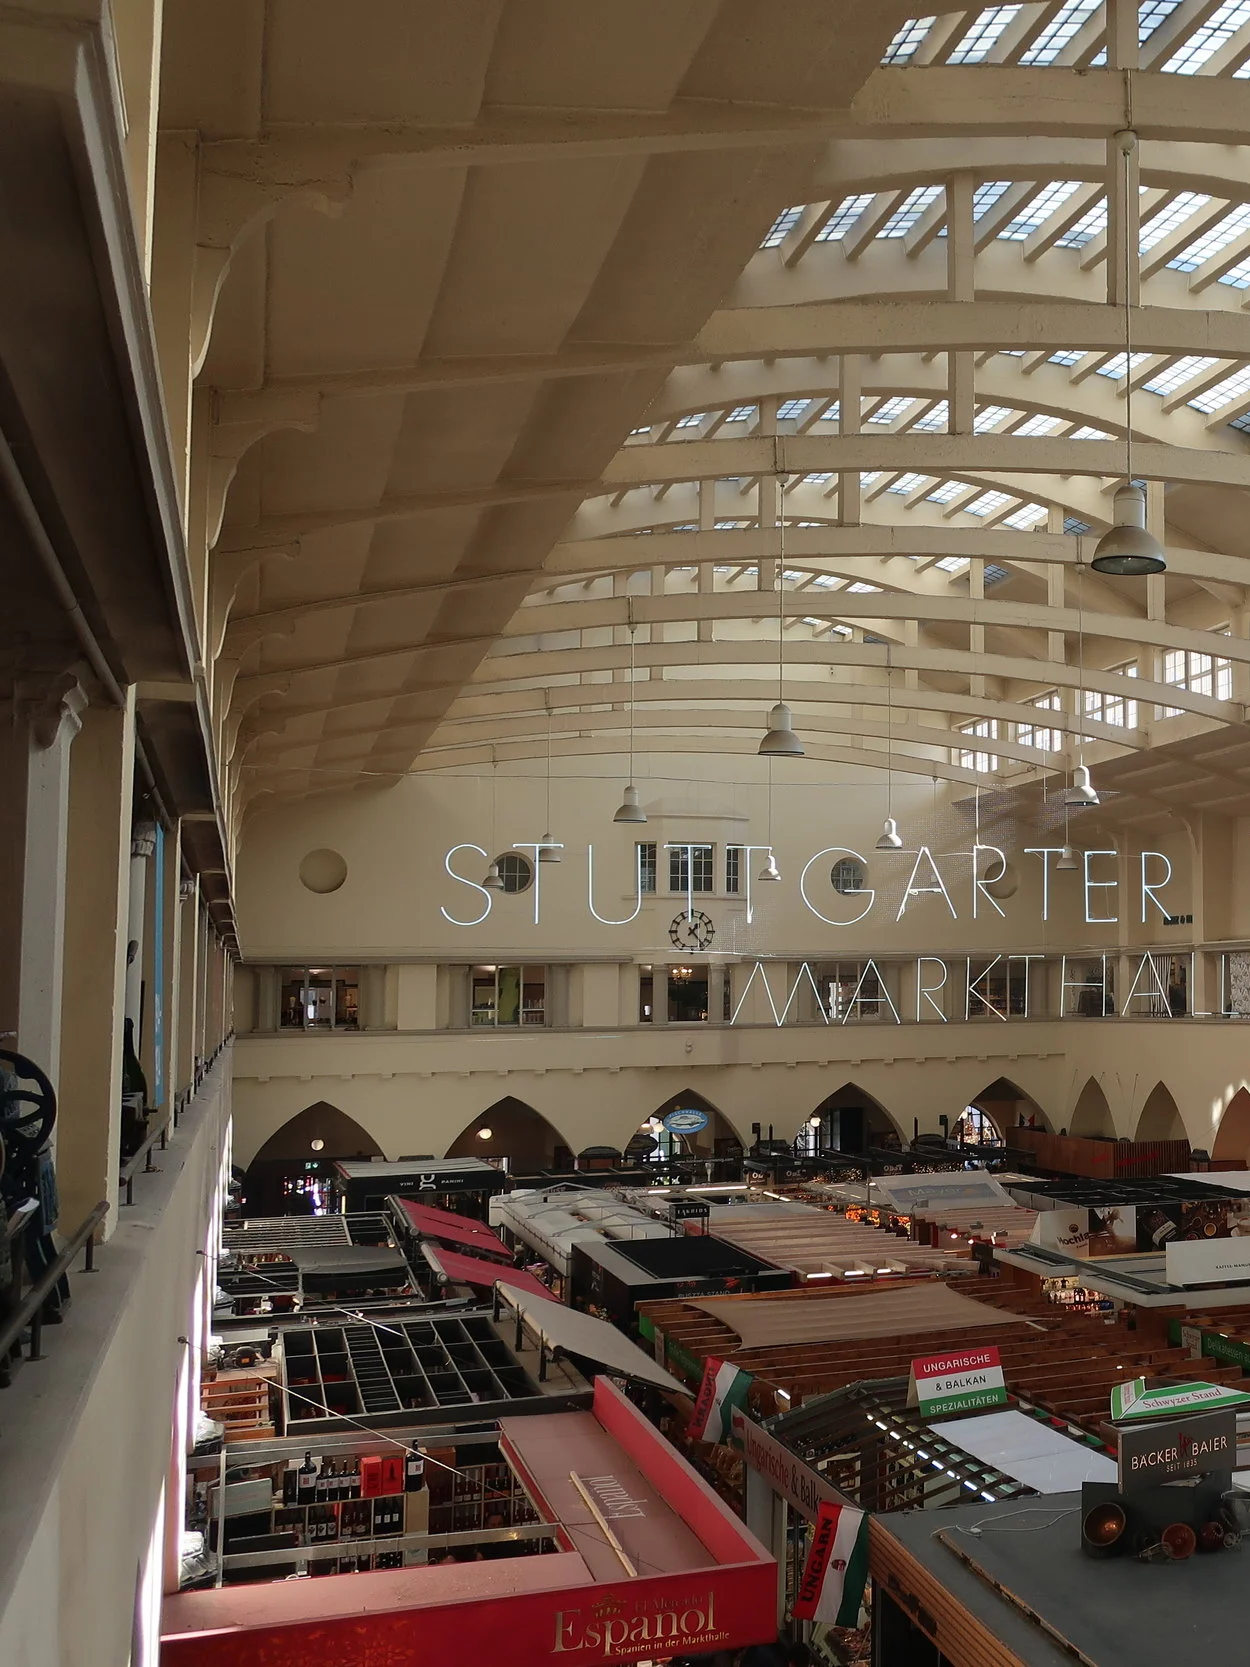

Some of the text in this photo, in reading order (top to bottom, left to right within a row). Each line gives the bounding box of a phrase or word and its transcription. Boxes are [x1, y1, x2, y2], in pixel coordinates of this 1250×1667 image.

[440, 843, 1172, 926] STUTTGARTER
[923, 1353, 991, 1373] UNGARISCHE
[935, 1375, 986, 1391] & BALKAN
[929, 1392, 999, 1415] SPEZIALITÄTEN
[1142, 1392, 1191, 1410] Schwyzer
[1192, 1387, 1222, 1402] Stand
[1130, 1435, 1228, 1470] BÄCKER BAIER
[745, 1429, 822, 1514] Ungarische & Balk
[1166, 1462, 1180, 1472] SEIT
[800, 1516, 834, 1603] UNGARN
[615, 1630, 730, 1656] Spanien in der Markthalle
